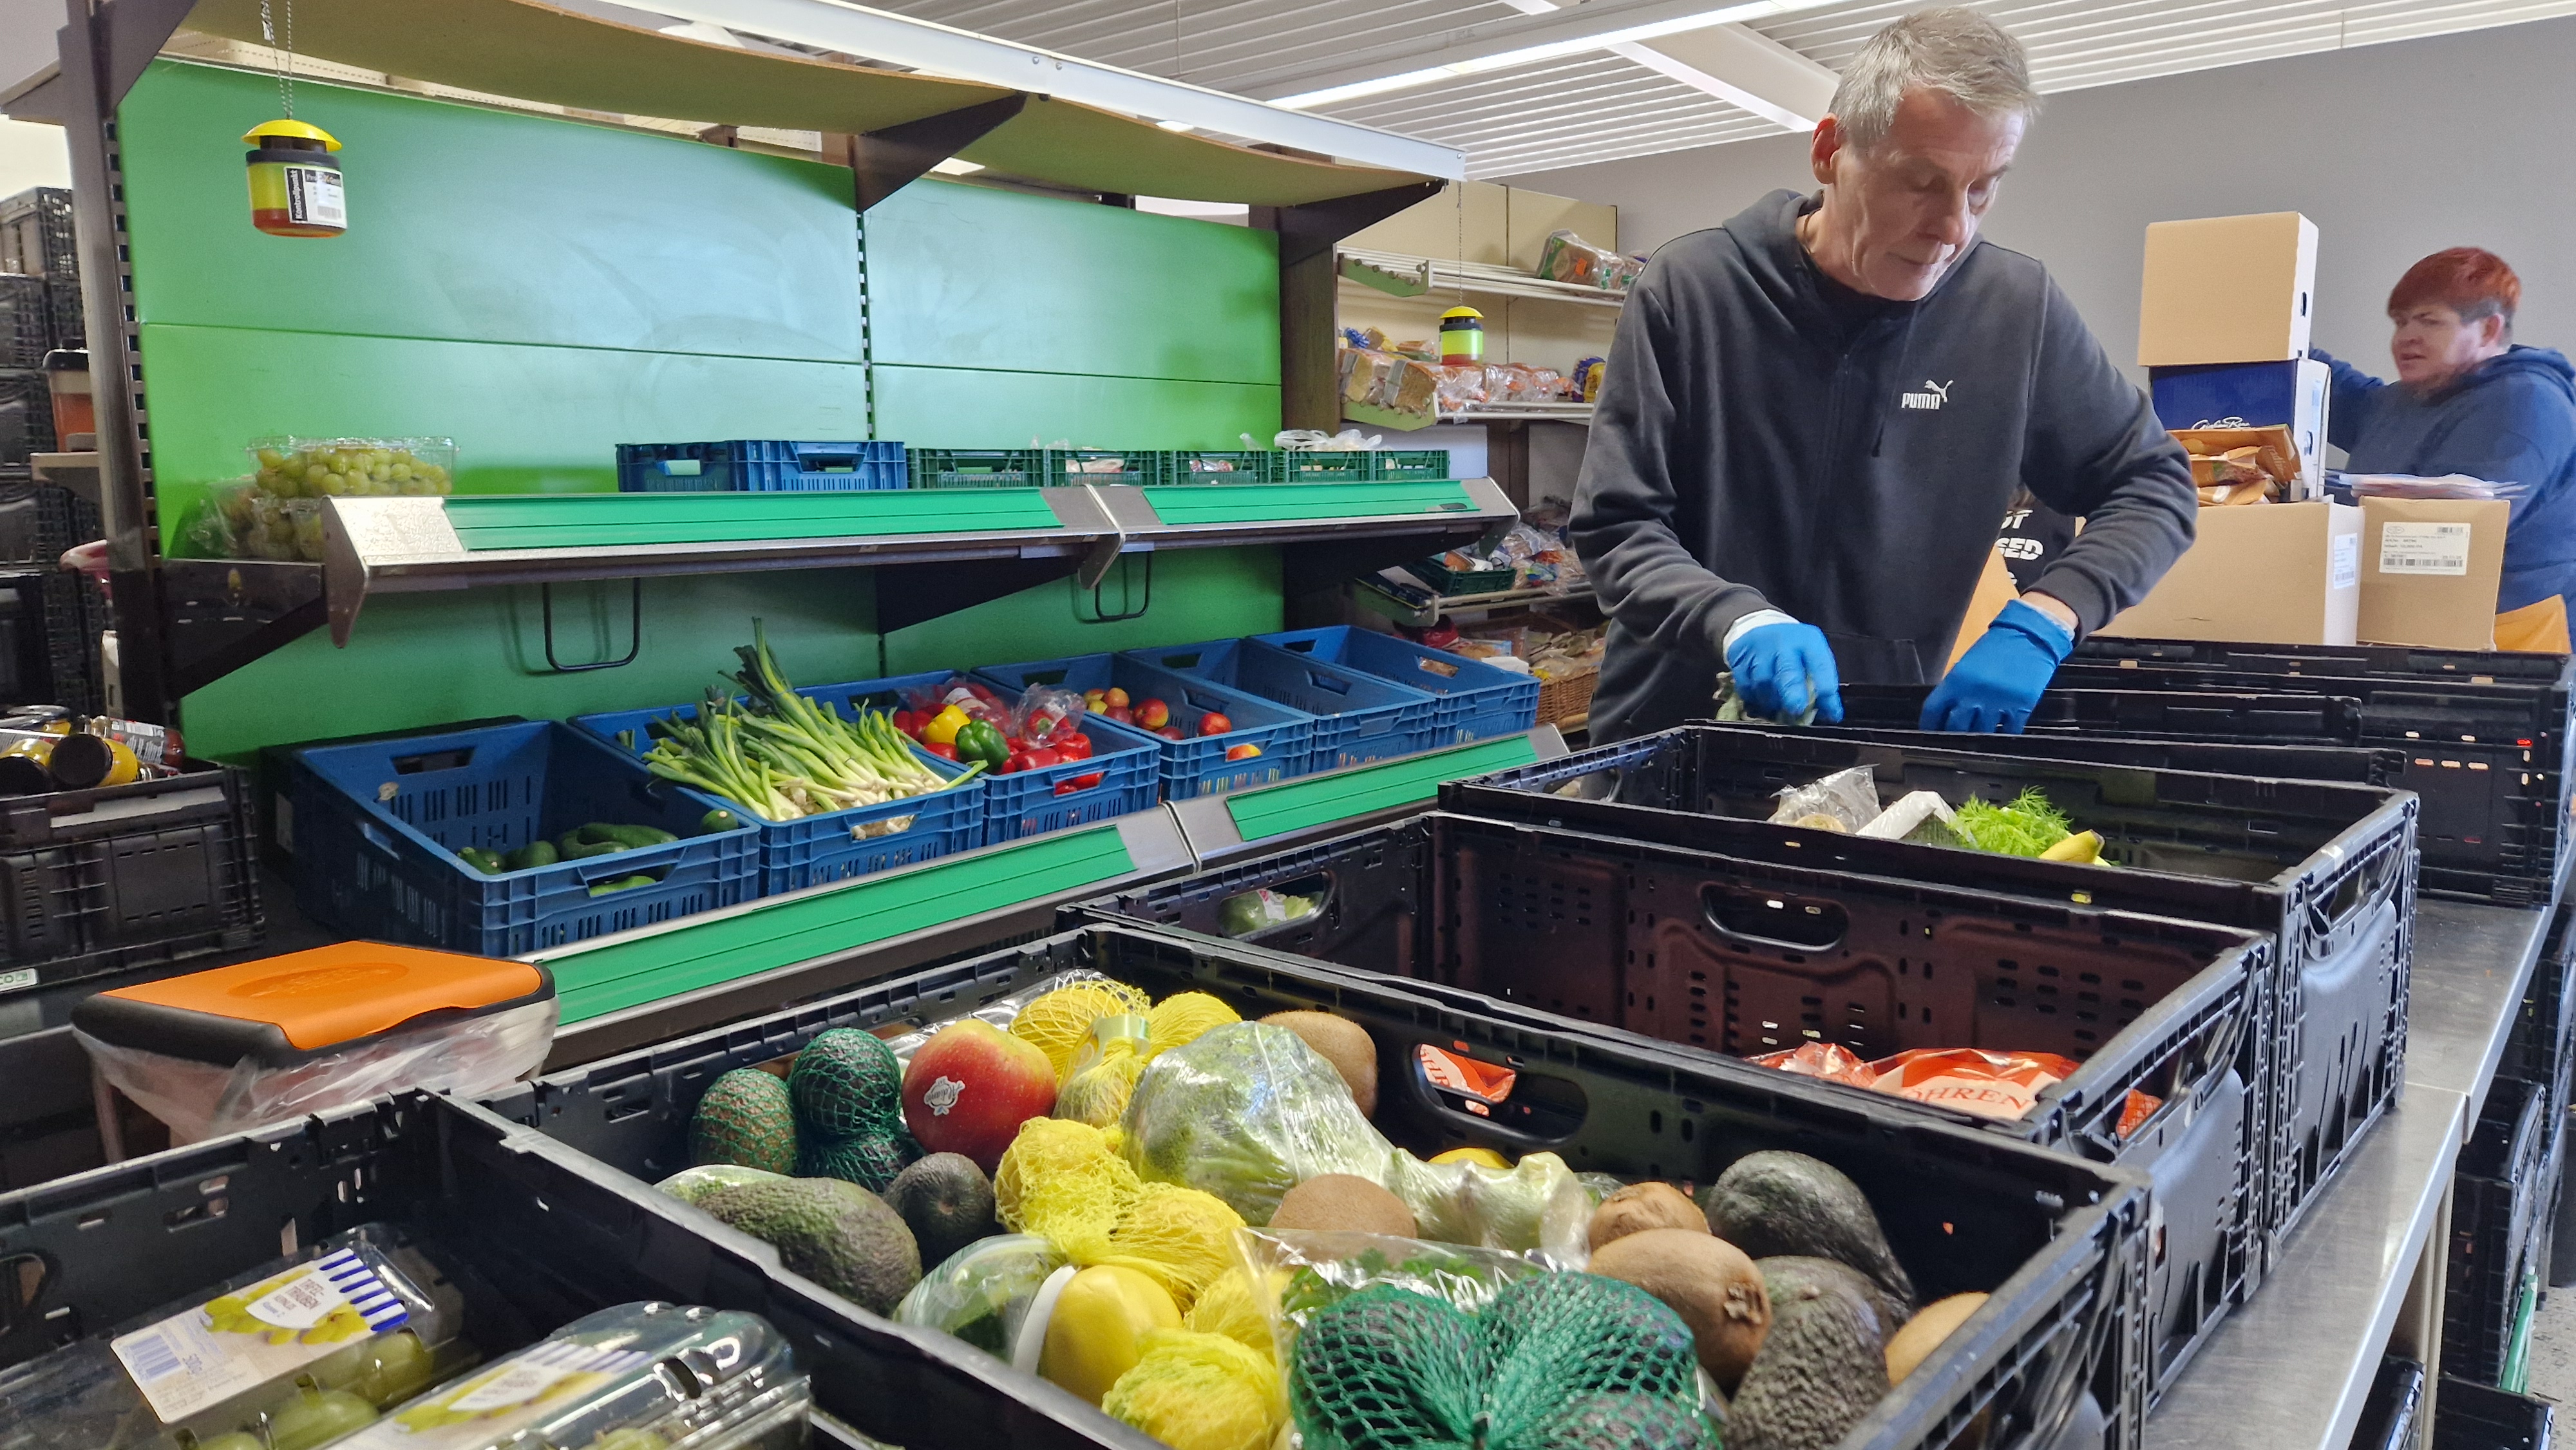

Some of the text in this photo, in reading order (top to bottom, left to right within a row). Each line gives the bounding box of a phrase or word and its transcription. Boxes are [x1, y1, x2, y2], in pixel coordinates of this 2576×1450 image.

[290, 169, 303, 220] Kontrollpunkt
[1901, 393, 1940, 410] PUMA
[925, 1083, 963, 1102] Aldiamo
[1904, 1088, 2032, 1110] ÖHREN
